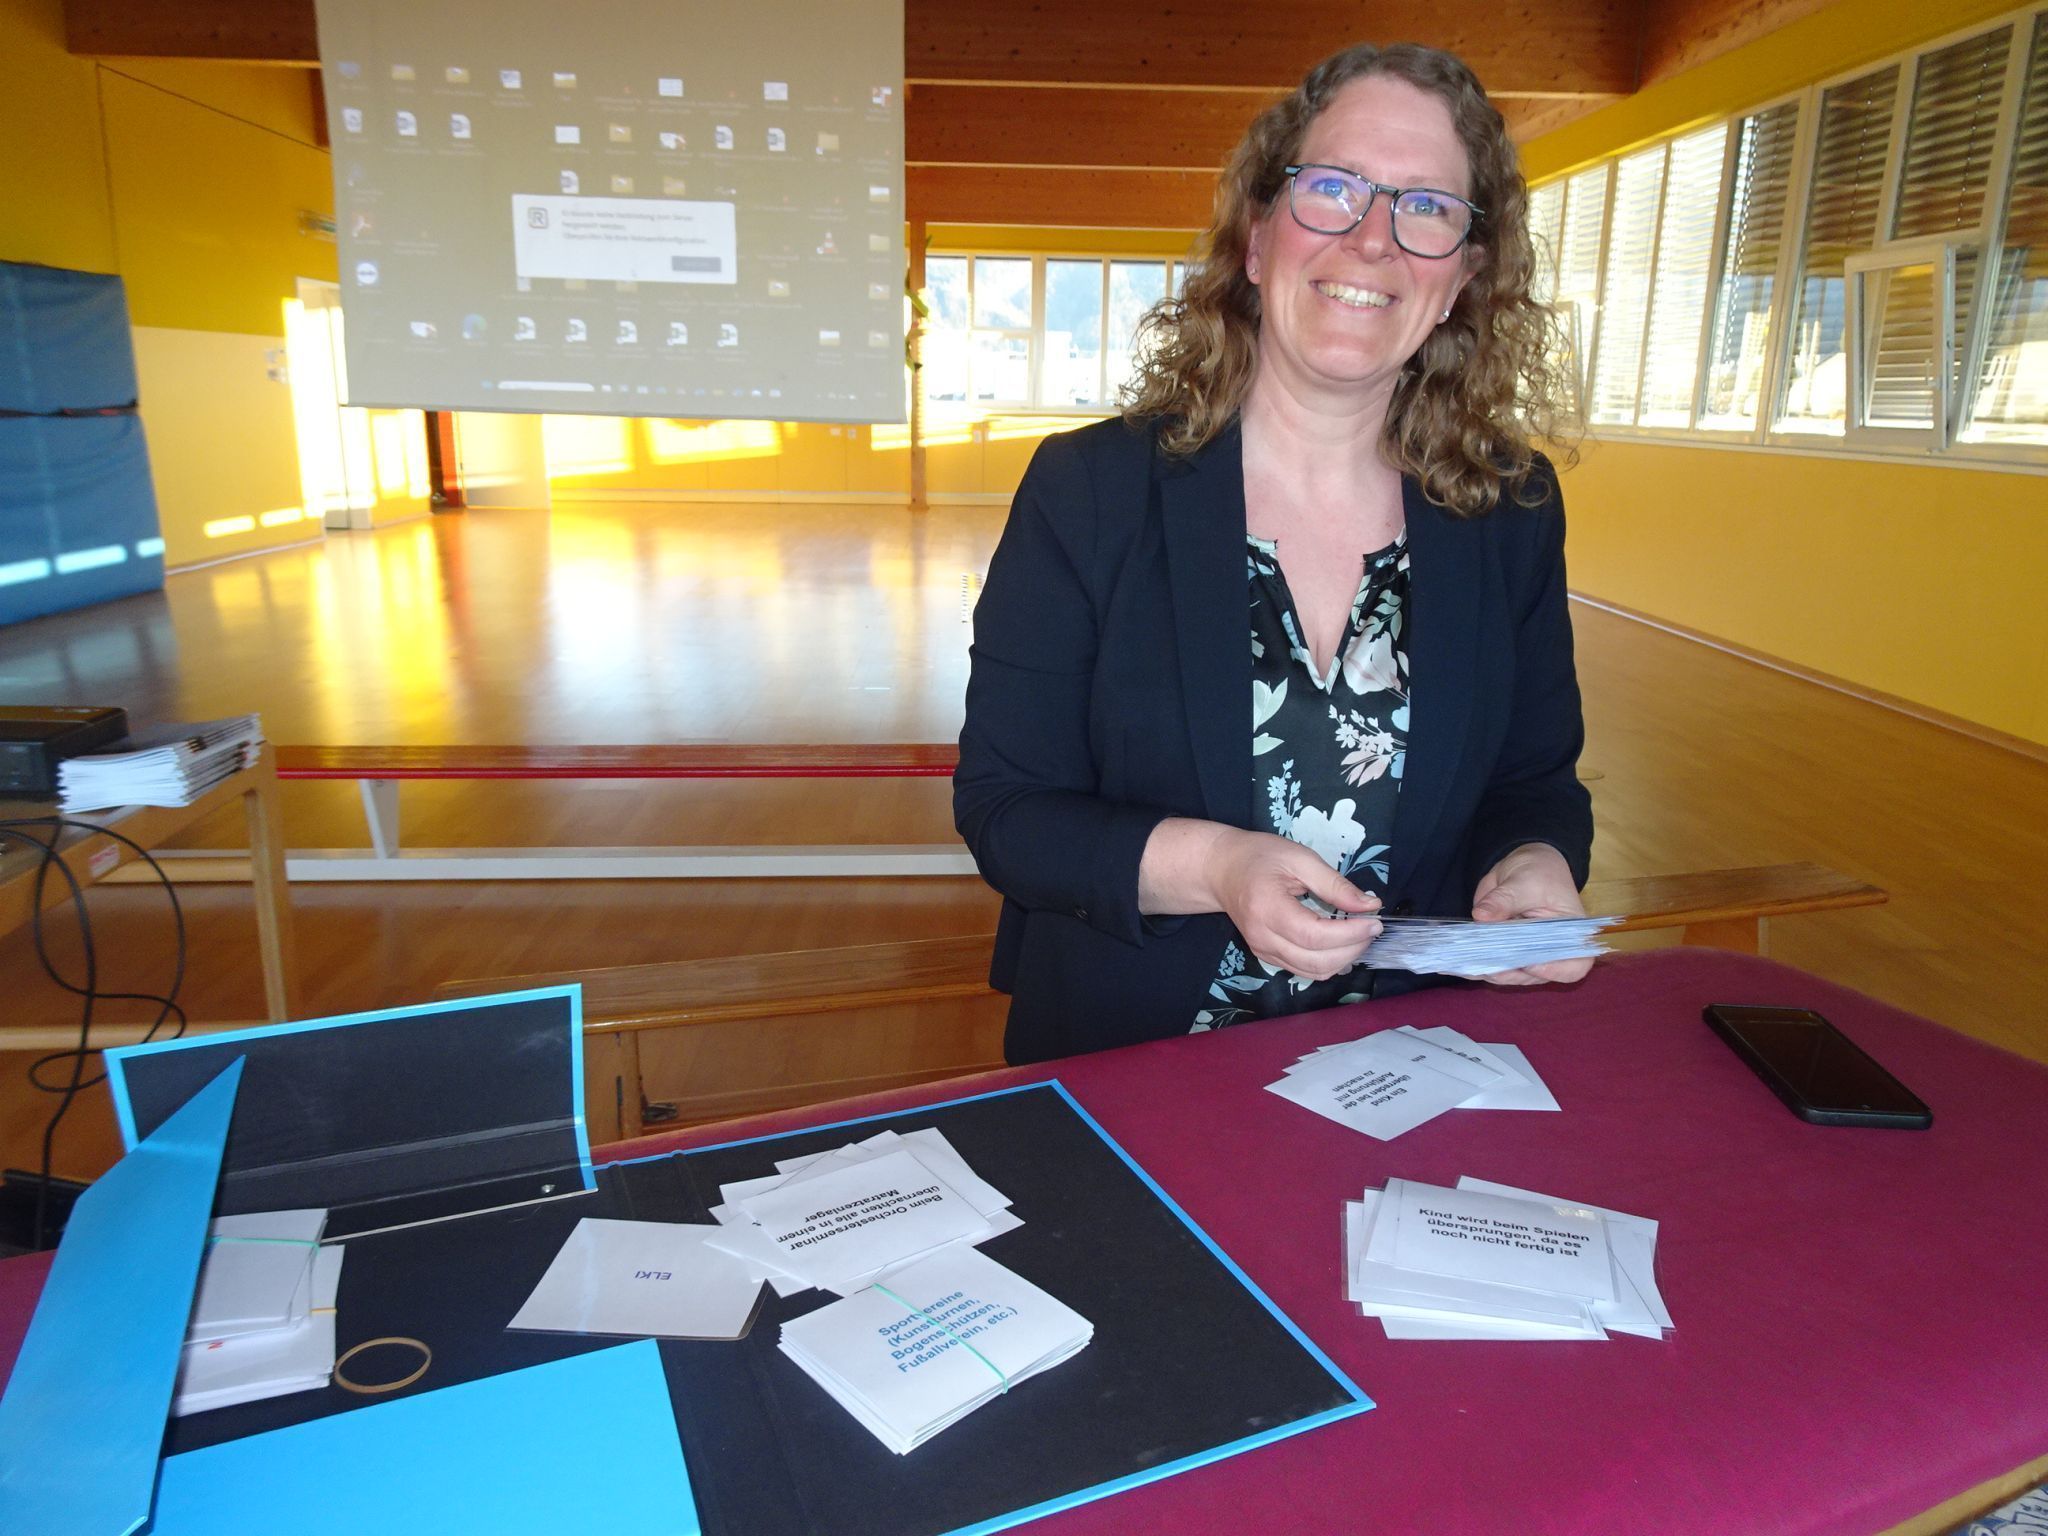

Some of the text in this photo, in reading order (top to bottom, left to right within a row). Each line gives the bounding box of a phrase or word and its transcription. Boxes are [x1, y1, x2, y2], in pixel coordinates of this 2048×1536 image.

[1332, 1075, 1365, 1092] machen
[1334, 1071, 1395, 1102] Aufführung mit
[1342, 1074, 1412, 1109] überreden bei der
[1370, 1087, 1408, 1106] Ein Kind
[776, 1185, 940, 1243] übernachten alle in einem
[805, 1189, 900, 1223] Matratzenlager
[790, 1194, 943, 1251] Beim Orchesterseminar
[1418, 1208, 1590, 1242] Kind wird beim Spielen
[1427, 1218, 1582, 1249] übersprungen, da es
[1431, 1228, 1579, 1257] noch nicht fertig ist
[634, 1270, 672, 1280] ELKI
[987, 1306, 1018, 1325] etc.)
